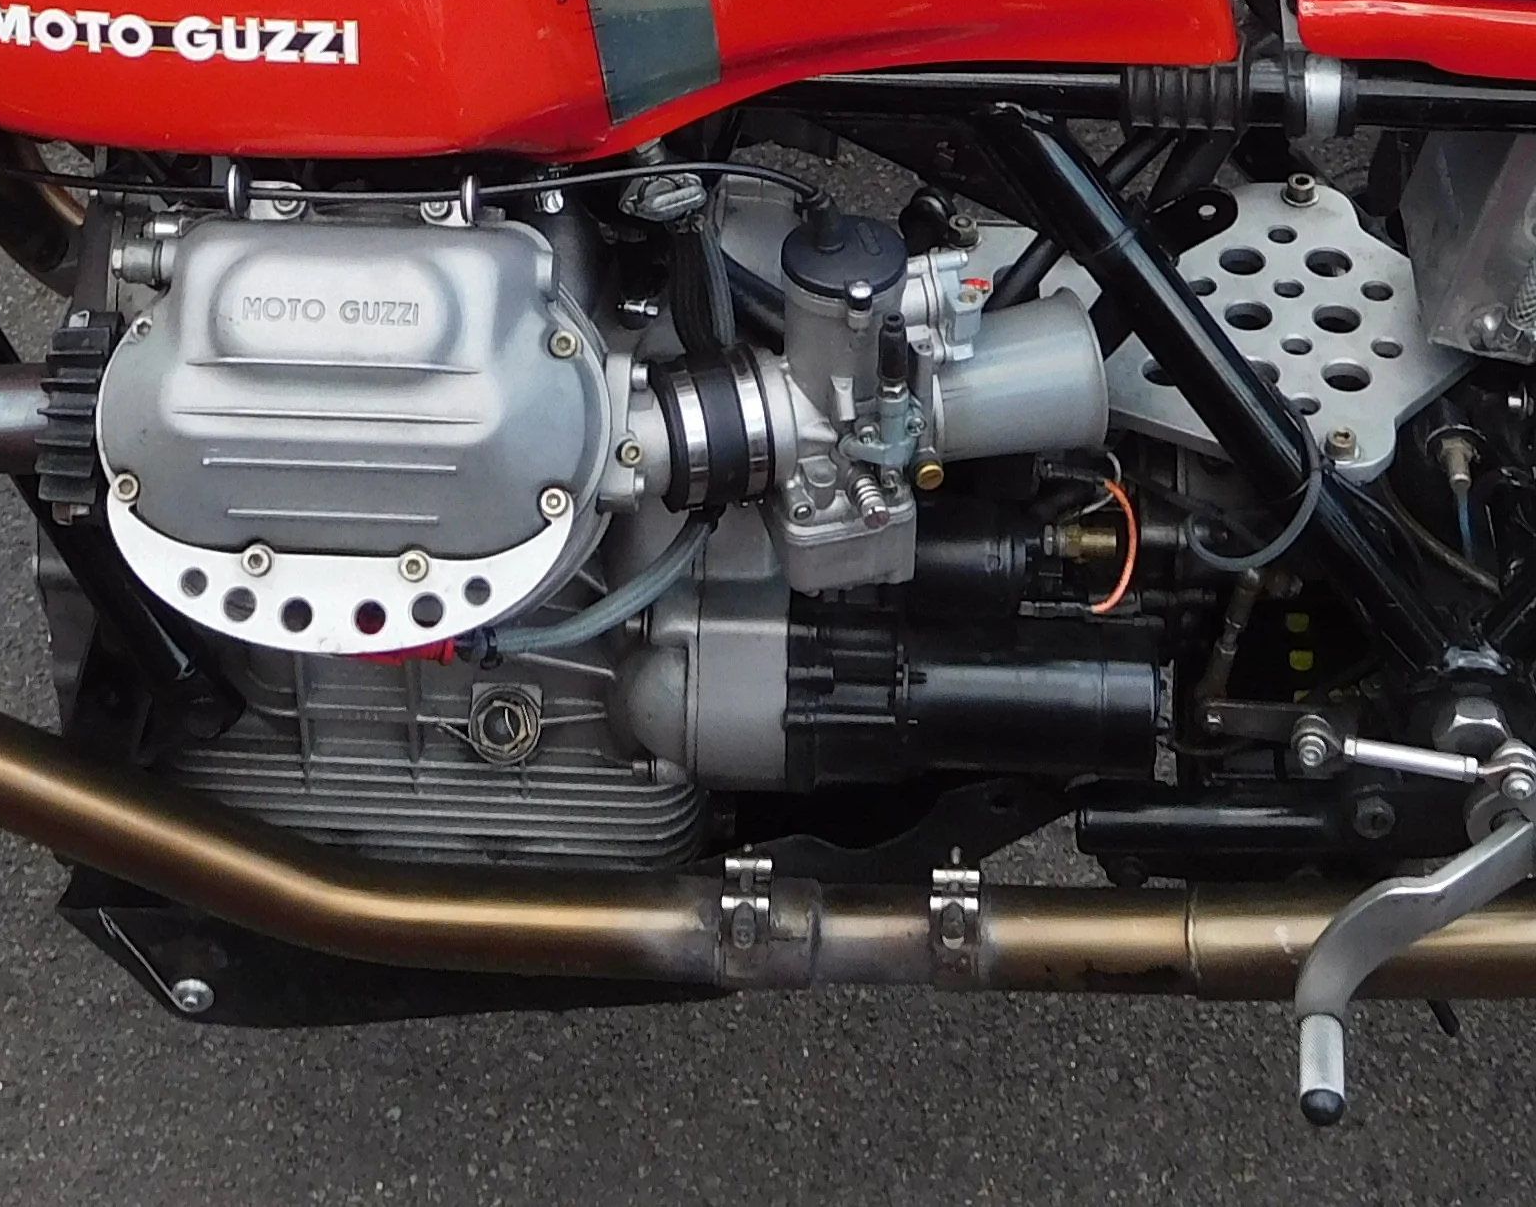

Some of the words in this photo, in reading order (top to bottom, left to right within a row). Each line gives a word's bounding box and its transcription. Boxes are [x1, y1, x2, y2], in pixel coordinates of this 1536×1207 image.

[172, 15, 360, 65] GUZZI
[242, 296, 326, 323] MOTO
[339, 299, 419, 326] GUZZI
